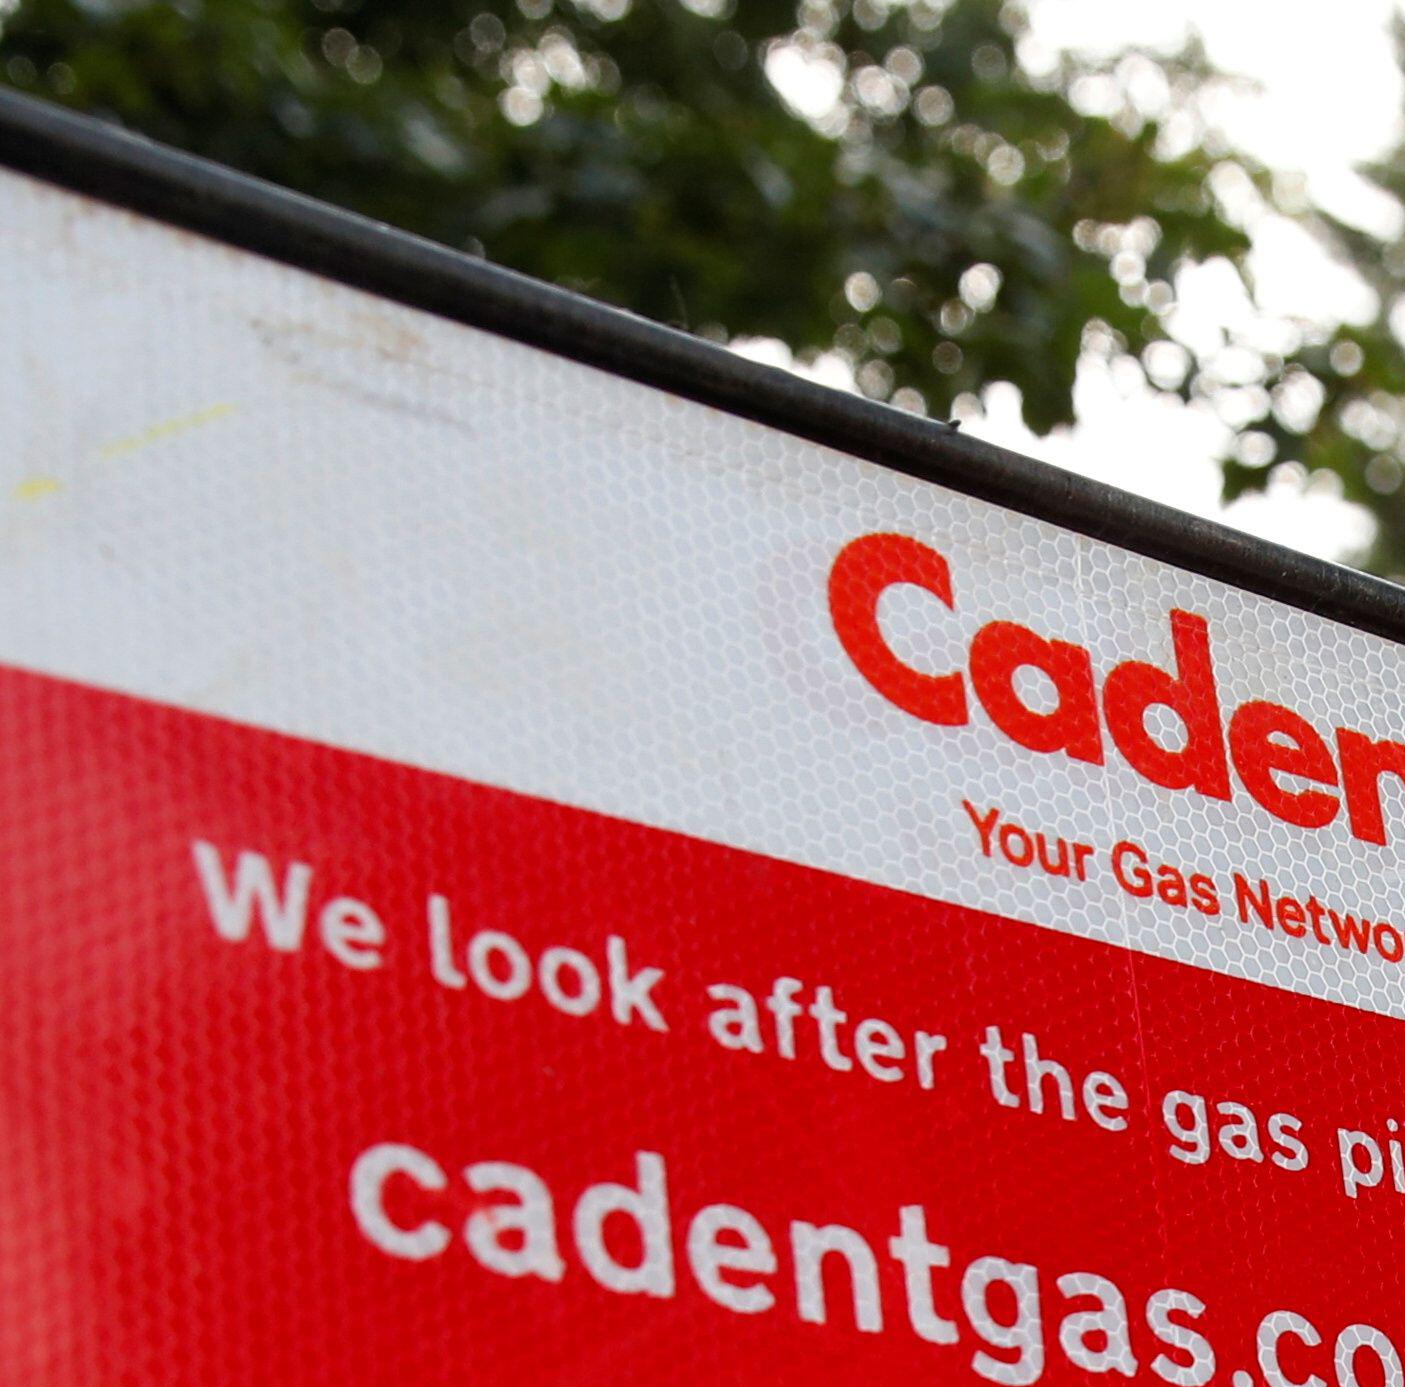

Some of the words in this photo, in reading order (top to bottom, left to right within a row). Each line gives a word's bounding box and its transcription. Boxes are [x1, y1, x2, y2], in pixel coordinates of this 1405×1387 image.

[962, 799, 1095, 881] Your
[1111, 840, 1222, 918] Gas
[194, 842, 384, 970] We
[430, 896, 667, 1031] look
[708, 978, 948, 1090] after
[979, 1027, 1128, 1132] the
[1162, 1090, 1308, 1172] gas
